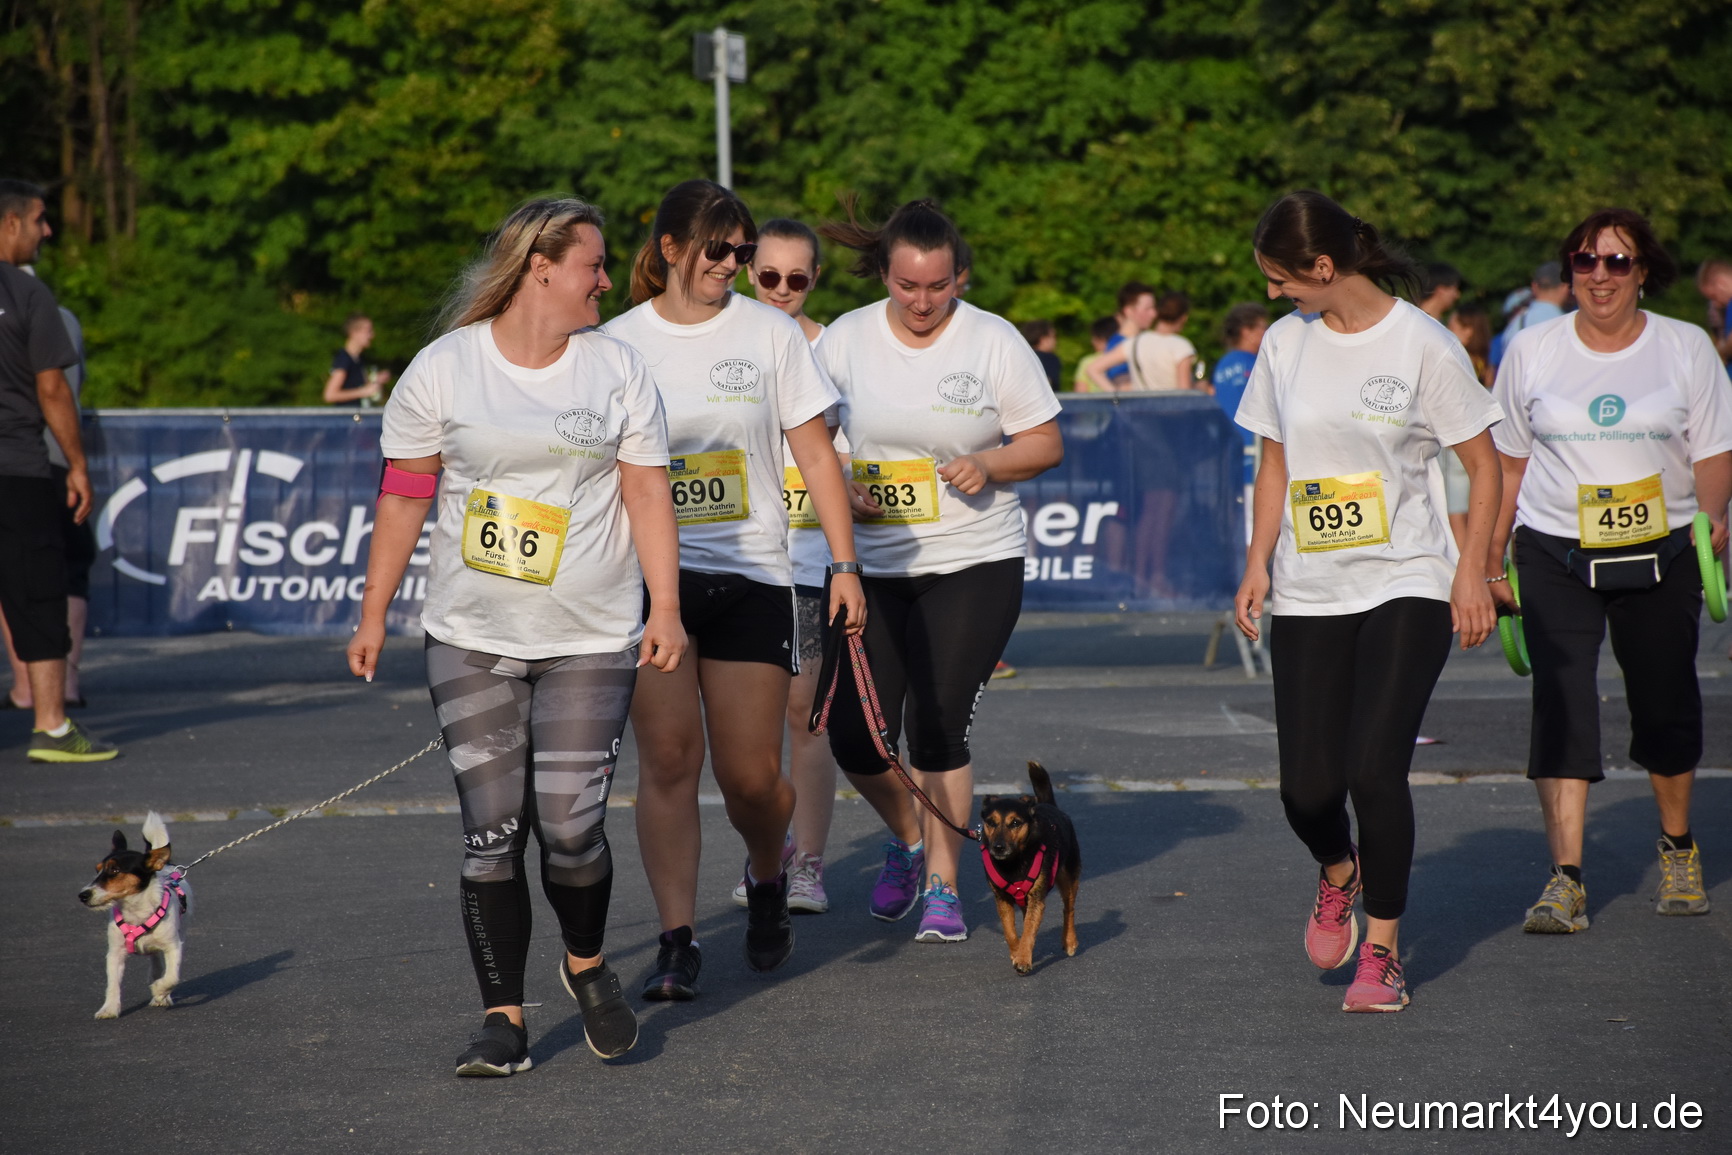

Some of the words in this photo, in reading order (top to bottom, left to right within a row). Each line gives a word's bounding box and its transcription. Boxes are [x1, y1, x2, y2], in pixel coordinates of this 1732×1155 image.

[716, 380, 755, 391] NATURKOST
[943, 392, 978, 404] NATURKOST
[1364, 396, 1403, 411] NATURKOST
[561, 430, 603, 445] NATURKOST
[1600, 430, 1645, 442] Pöllinger
[548, 445, 565, 456] Wir
[671, 477, 725, 506] 690
[868, 483, 916, 507] 683
[709, 503, 736, 511] Kathrin
[887, 507, 922, 515] Josephine
[1309, 501, 1364, 532] 693
[1598, 503, 1649, 530] 459
[1320, 531, 1337, 539] Wolf
[1338, 529, 1356, 539] Anja
[1598, 530, 1630, 538] Pöllinger
[1631, 525, 1653, 534] Gisela
[480, 521, 540, 558] 686
[484, 550, 506, 561] Fürst
[598, 775, 608, 801] Reebok
